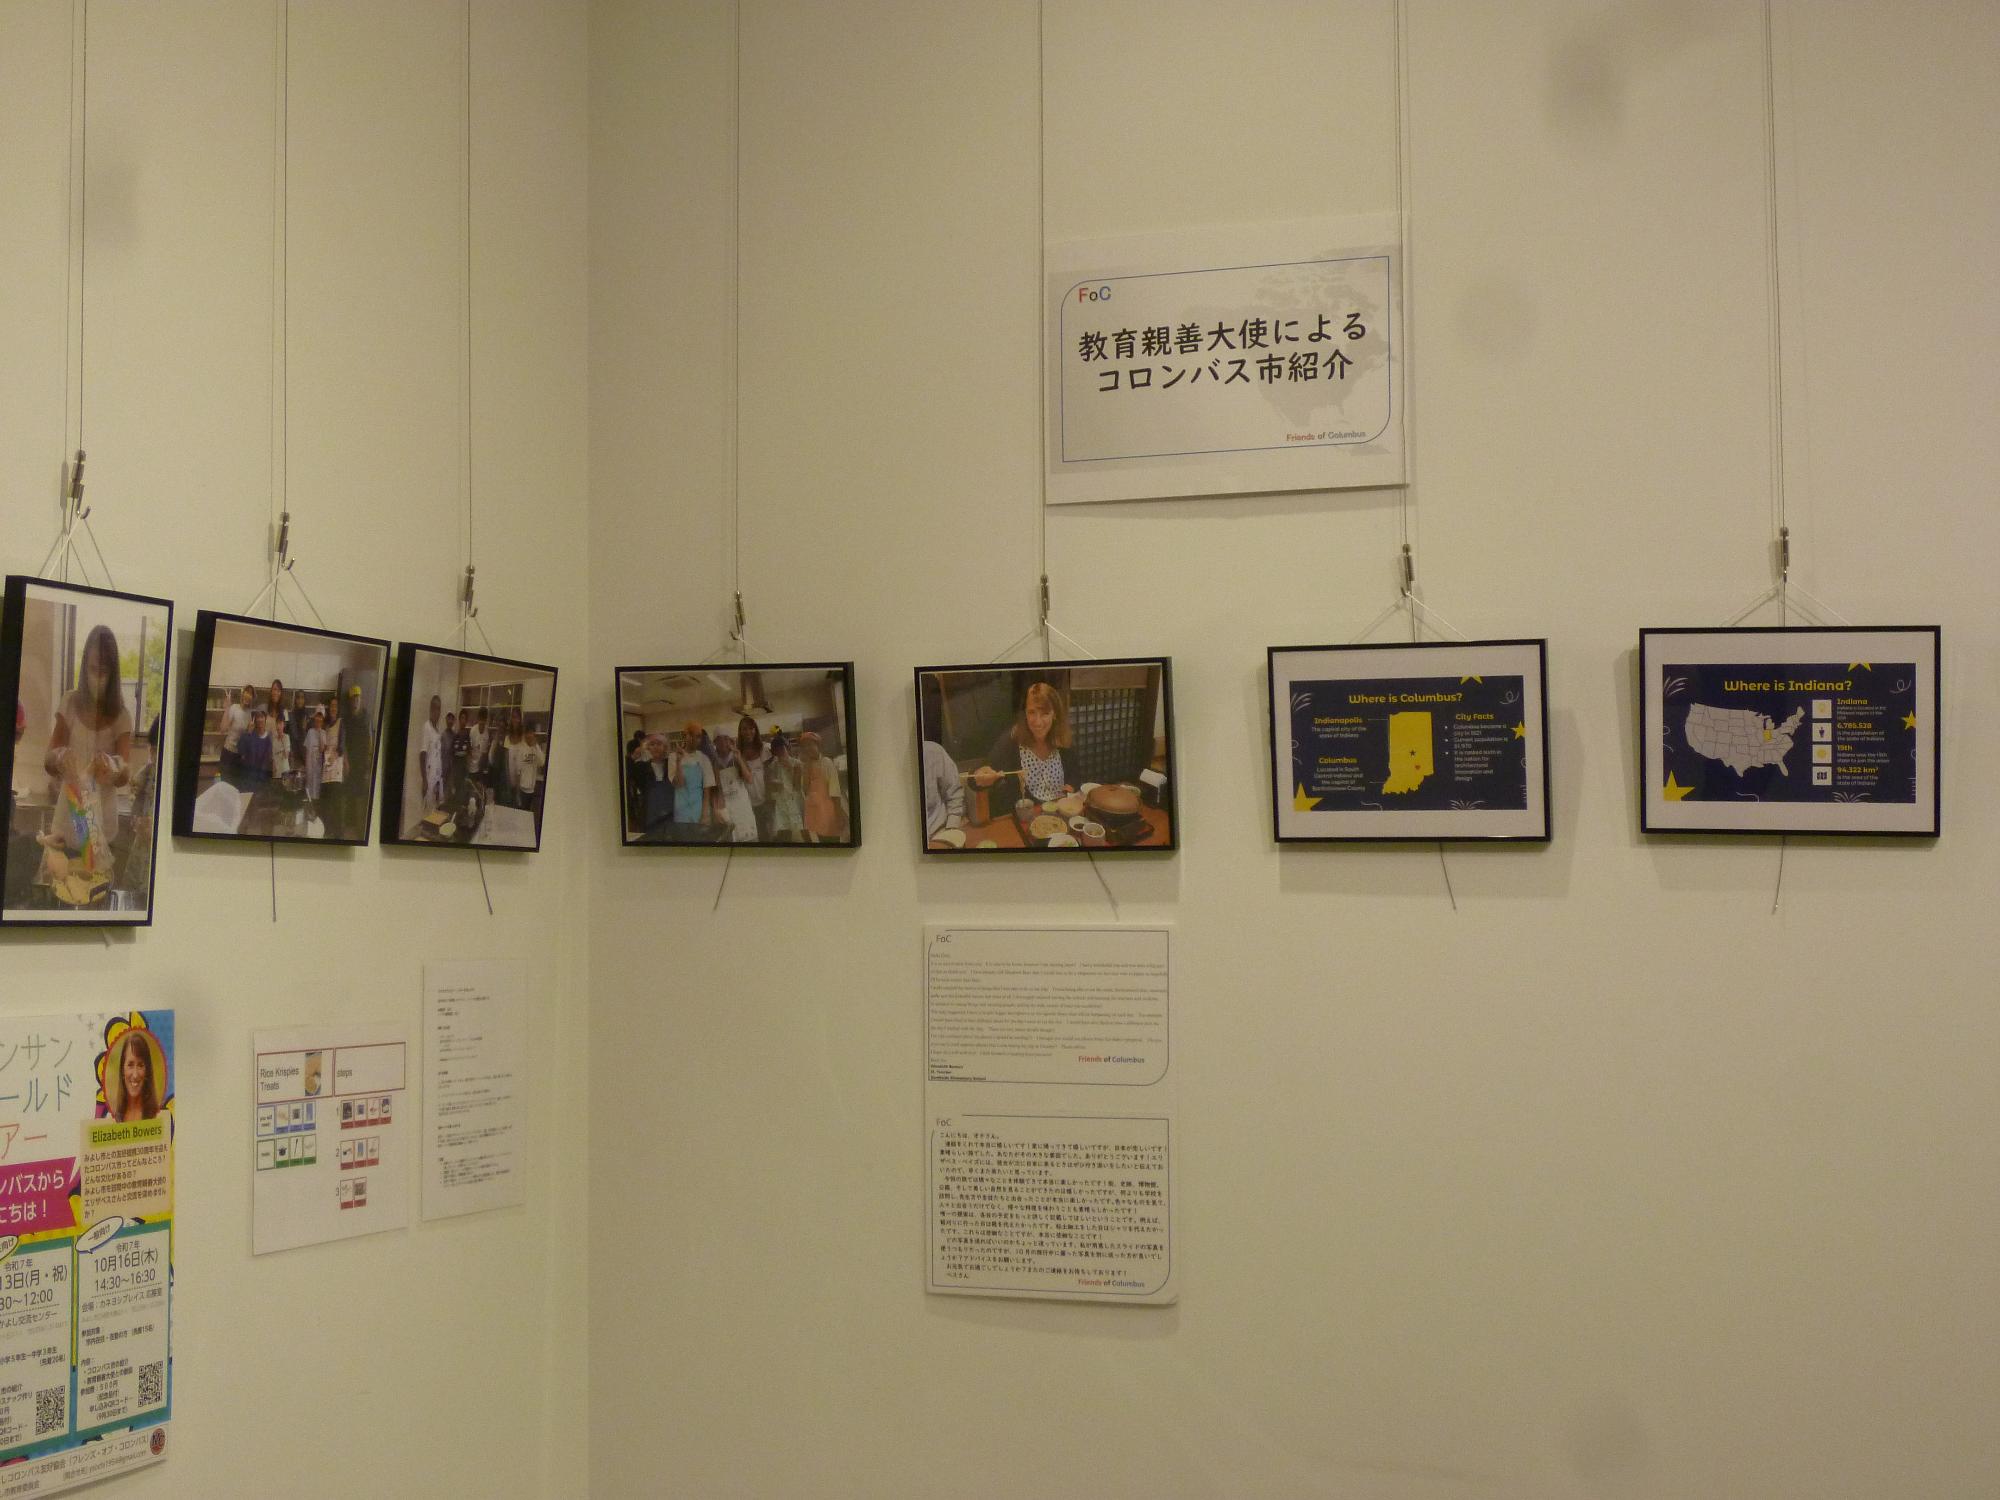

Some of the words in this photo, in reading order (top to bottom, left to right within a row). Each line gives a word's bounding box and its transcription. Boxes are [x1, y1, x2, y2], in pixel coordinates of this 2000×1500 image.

[1079, 286, 1111, 303] FoC
[1079, 312, 1366, 362] 教育親善大使による
[1099, 349, 1353, 391] コロンバス市紹介
[1286, 432, 1315, 442] Friends
[1317, 432, 1326, 440] of
[1327, 431, 1366, 440] Columbus
[1725, 679, 1770, 691] Where
[1773, 679, 1784, 691] is
[1788, 679, 1852, 691] Indiana?
[1349, 694, 1385, 704] Where
[1389, 692, 1397, 703] is
[1400, 692, 1463, 702] Columbus?
[1314, 717, 1362, 725] Indianapolis
[1455, 713, 1471, 721] City
[1473, 713, 1495, 721] Facts
[1078, 1055, 1103, 1063] Friends
[1104, 1055, 1111, 1063] of
[1112, 1056, 1145, 1064] Columbus
[92, 1129, 131, 1142] Elizabeth
[132, 1126, 162, 1138] Bowers
[1112, 1280, 1145, 1288] Columbus
